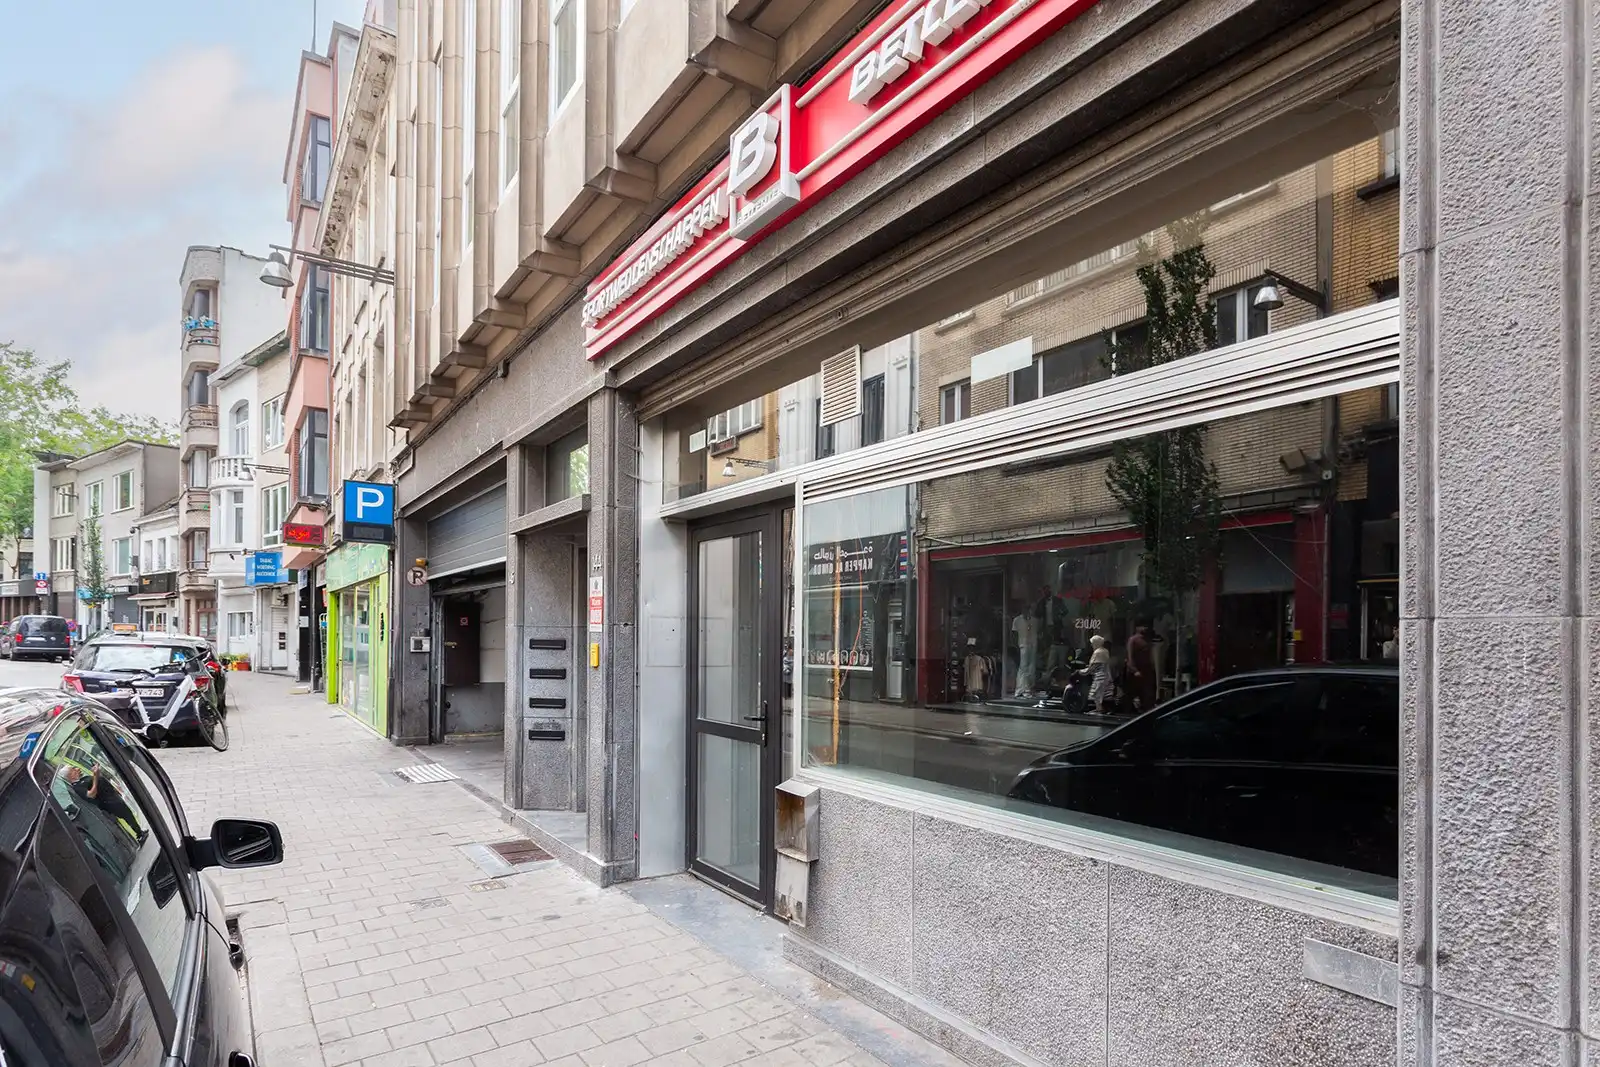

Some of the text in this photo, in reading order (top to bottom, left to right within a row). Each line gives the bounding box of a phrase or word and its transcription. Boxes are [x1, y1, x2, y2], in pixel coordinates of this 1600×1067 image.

[726, 112, 778, 197] B
[581, 187, 728, 327] SPORTWEDDENSCHAPPEN
[356, 486, 385, 519] P
